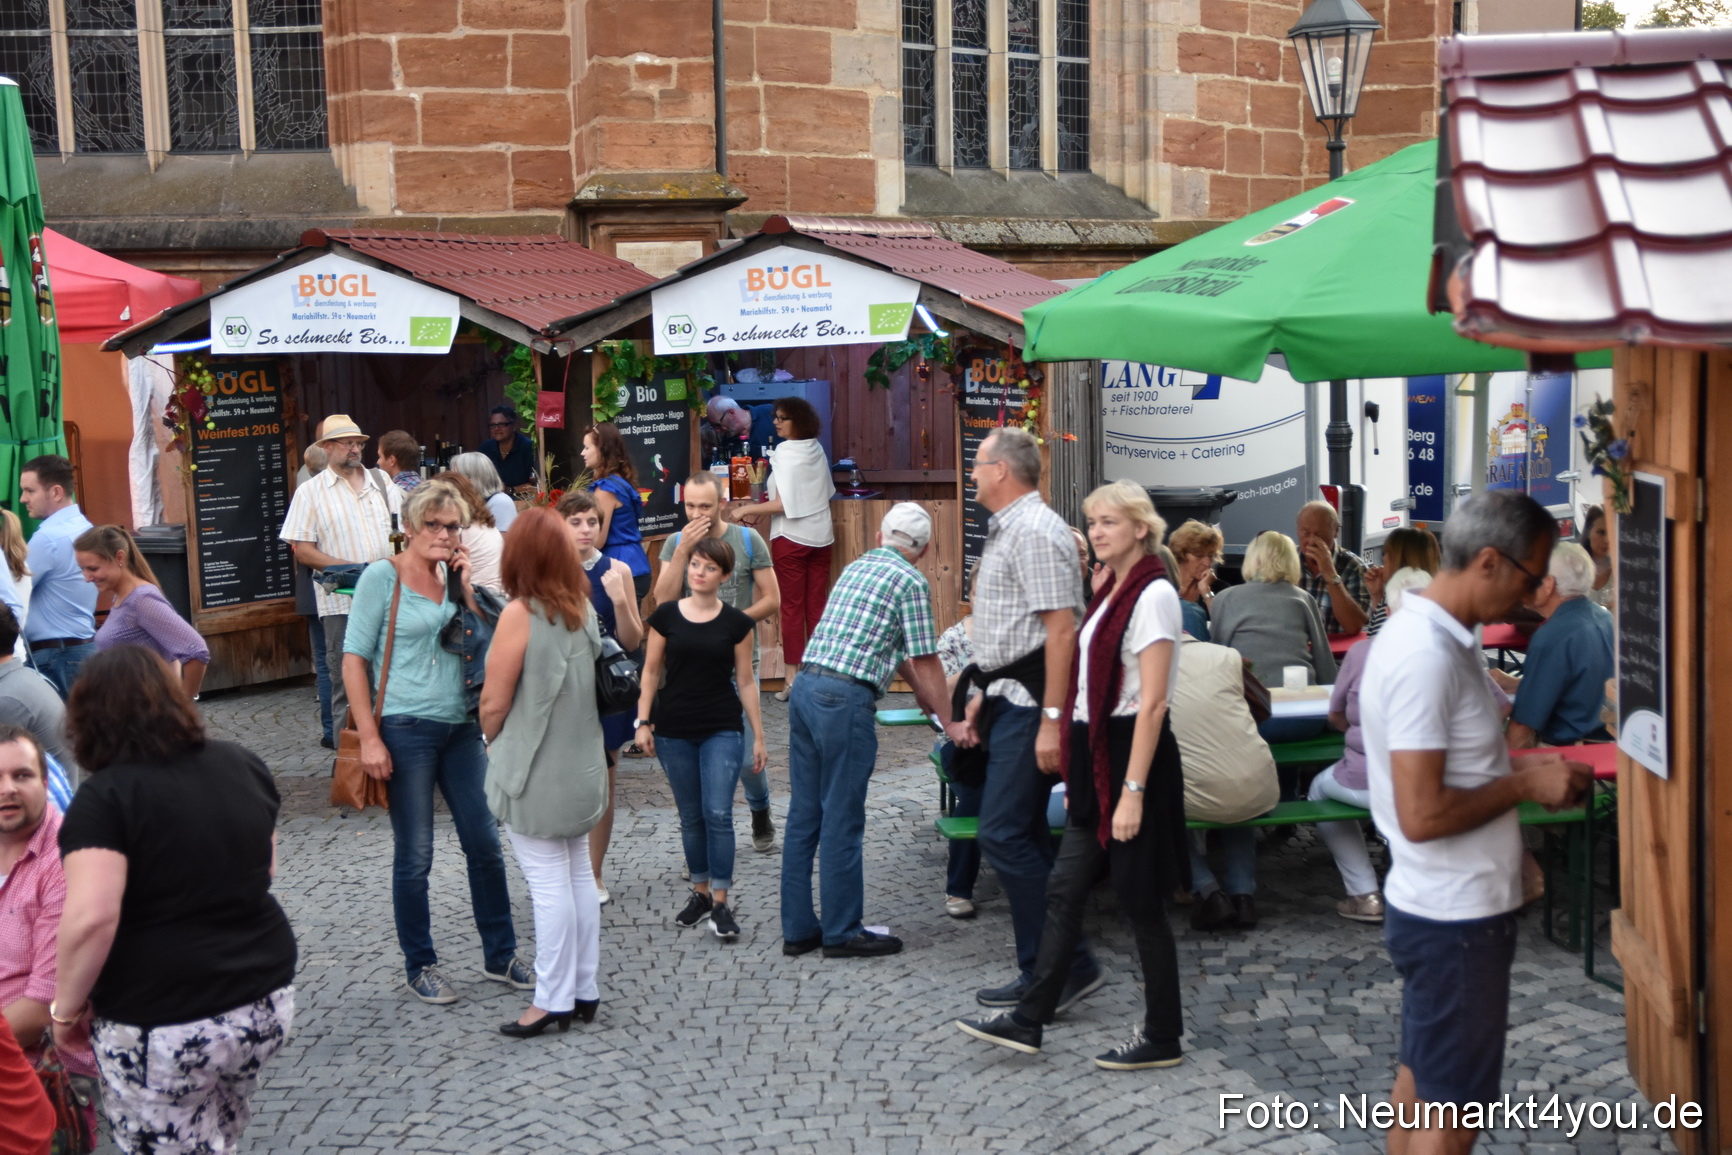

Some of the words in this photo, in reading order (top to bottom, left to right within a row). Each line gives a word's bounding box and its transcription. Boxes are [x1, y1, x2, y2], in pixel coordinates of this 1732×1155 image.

[747, 264, 831, 291] BÖGL
[299, 273, 376, 297] BÖGL
[763, 292, 800, 302] dienstleistung
[801, 291, 806, 299] &
[807, 290, 832, 300] werbung
[314, 300, 346, 309] dienstleistung
[353, 300, 376, 308] werbung
[740, 304, 779, 316] Mariahilfstr.
[801, 304, 832, 313] Neumarkt
[292, 312, 330, 321] Mariahilfstr.
[346, 312, 376, 320] Neumarkt
[257, 328, 279, 345] So
[284, 328, 352, 345] schmeckt
[359, 328, 406, 345] Bio...
[703, 326, 727, 344] So
[732, 322, 808, 341] schmeckt
[815, 319, 865, 337] Bio...
[1101, 362, 1177, 388] LANG
[217, 397, 249, 405] dienstleistung
[255, 395, 277, 403] werbung
[635, 385, 657, 403] Bio
[1111, 391, 1130, 403] seit
[1133, 390, 1158, 402] 1900
[249, 406, 275, 415] Neumarkt
[636, 413, 664, 422] Prosecco
[668, 411, 684, 420] Hugo
[1120, 404, 1194, 416] Fischbraterei
[197, 426, 250, 440] Weinfest
[252, 423, 280, 436] 2016
[632, 424, 651, 435] Sprizz
[652, 423, 679, 432] Erdbeere
[643, 437, 656, 445] aus
[1106, 441, 1176, 460] Partyservice
[1180, 450, 1188, 459] +
[1192, 443, 1245, 460] Catering
[1418, 448, 1435, 461] 48
[1236, 477, 1298, 501] isch-lang.de
